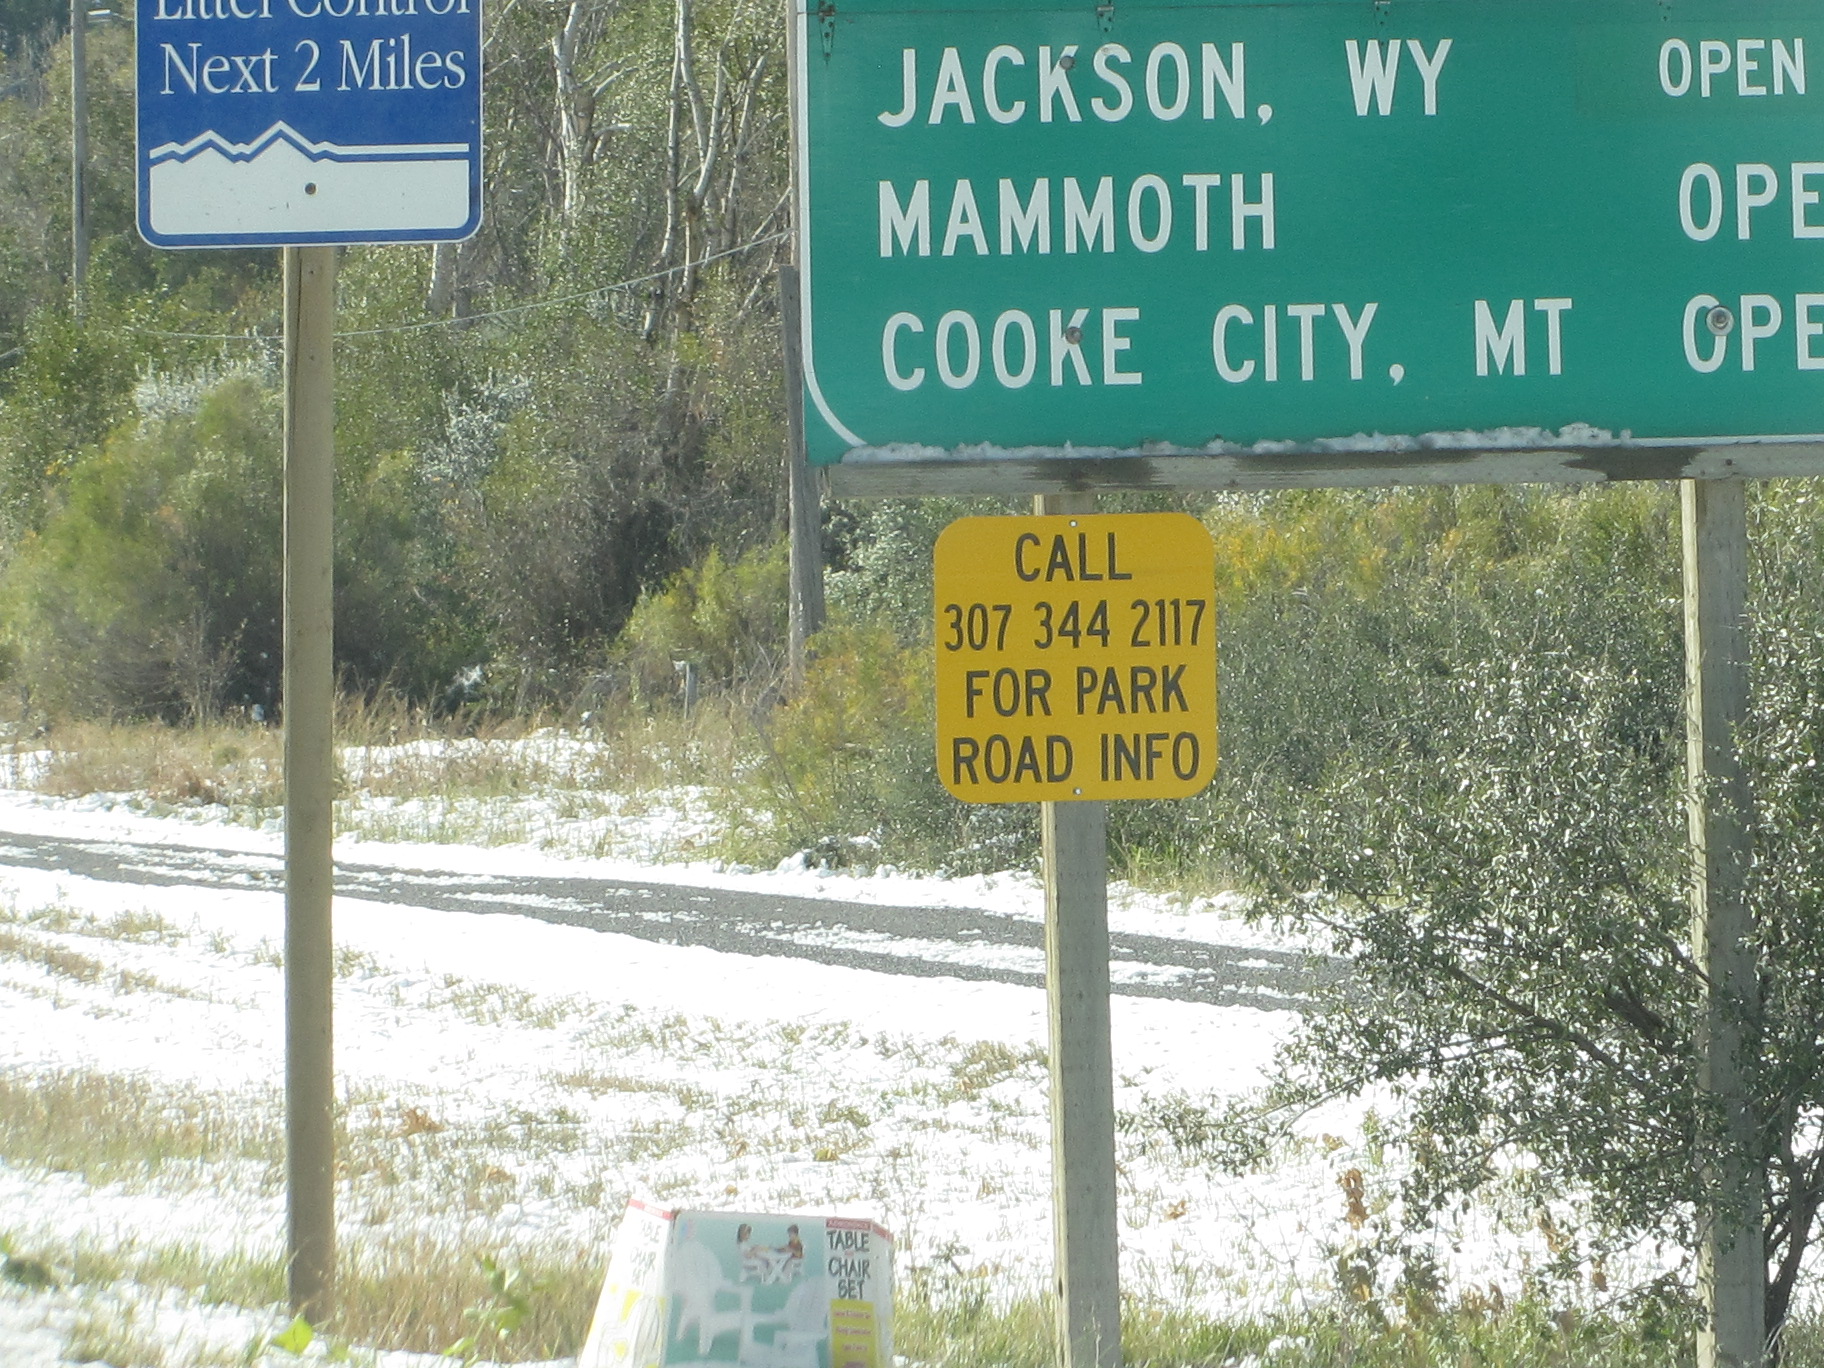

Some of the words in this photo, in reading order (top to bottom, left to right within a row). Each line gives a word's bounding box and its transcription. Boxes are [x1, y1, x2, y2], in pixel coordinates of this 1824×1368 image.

[160, 43, 278, 94] Next
[295, 40, 320, 91] 2
[337, 34, 465, 91] Miles
[878, 42, 1272, 127] JACKSON,
[1345, 39, 1452, 116] WY
[1659, 38, 1805, 97] OPEN
[879, 173, 1274, 257] MAMMOTH
[883, 308, 1142, 391] COOKE
[1213, 303, 1404, 385] CITY,
[1475, 298, 1572, 376] MT
[1016, 532, 1132, 582] CALL
[944, 604, 1011, 651] 307
[1034, 600, 1110, 649] 344
[1131, 599, 1205, 647] 2117
[966, 668, 1052, 718] FOR
[1077, 665, 1188, 715] PARK
[953, 734, 1073, 785] ROAD
[1101, 732, 1199, 781] INFO
[827, 1230, 870, 1252] TABLE
[829, 1256, 871, 1279] CHAIR
[838, 1279, 865, 1300] SET
